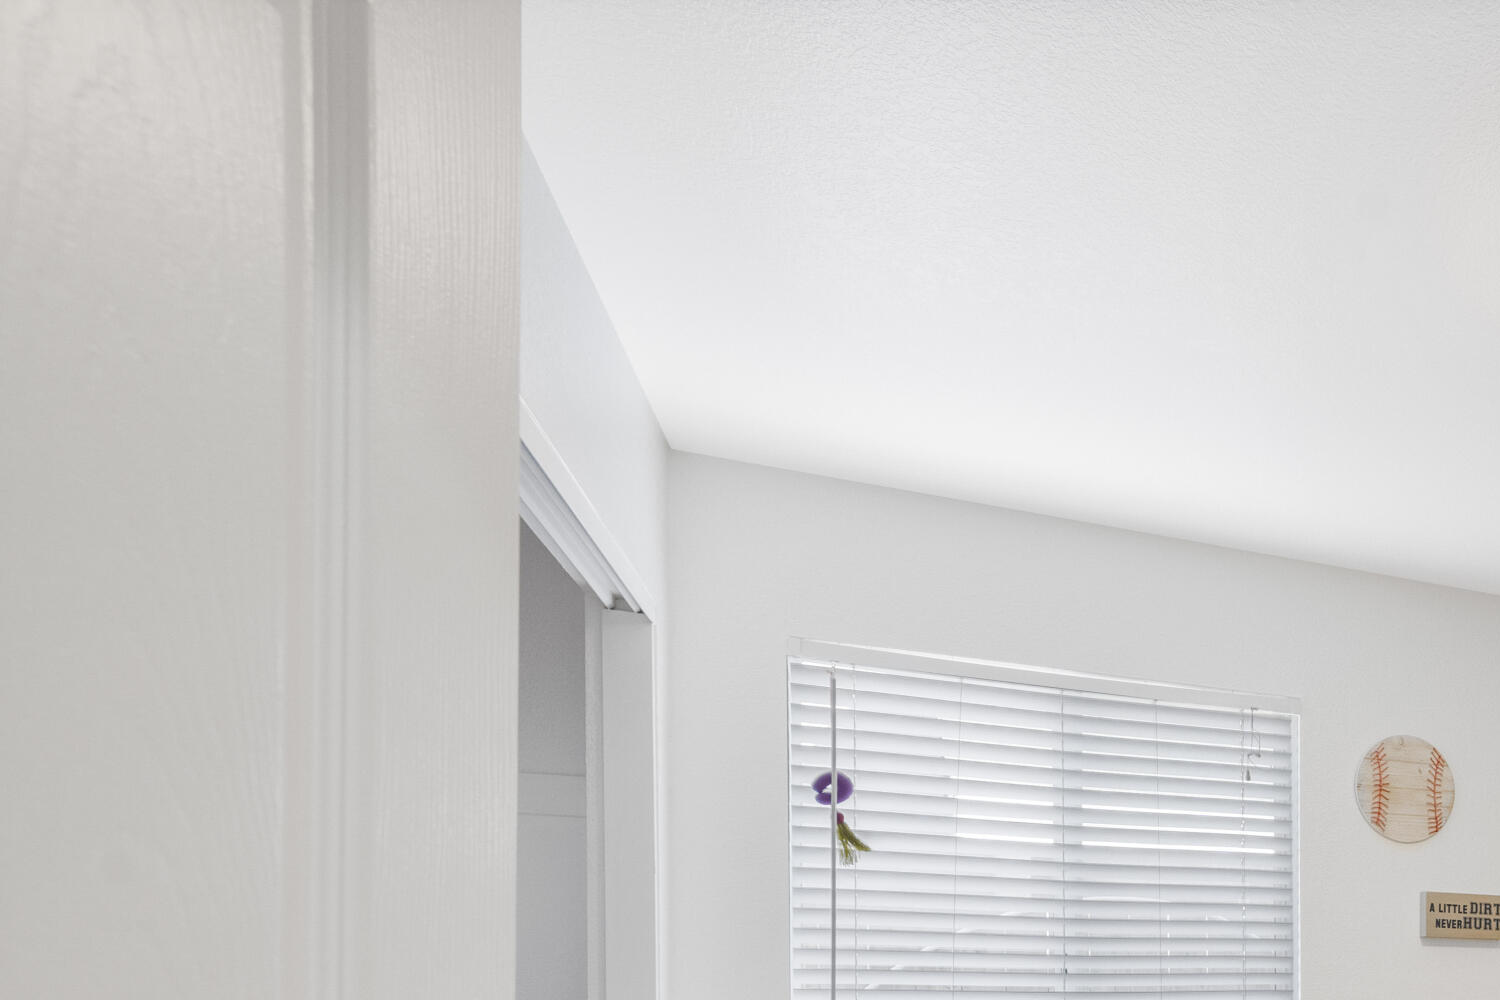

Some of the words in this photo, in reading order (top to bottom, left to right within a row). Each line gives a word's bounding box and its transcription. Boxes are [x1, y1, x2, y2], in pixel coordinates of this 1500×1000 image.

[1429, 902, 1435, 913] A
[1438, 903, 1468, 914] LITTLE
[1435, 918, 1463, 929] NEVER
